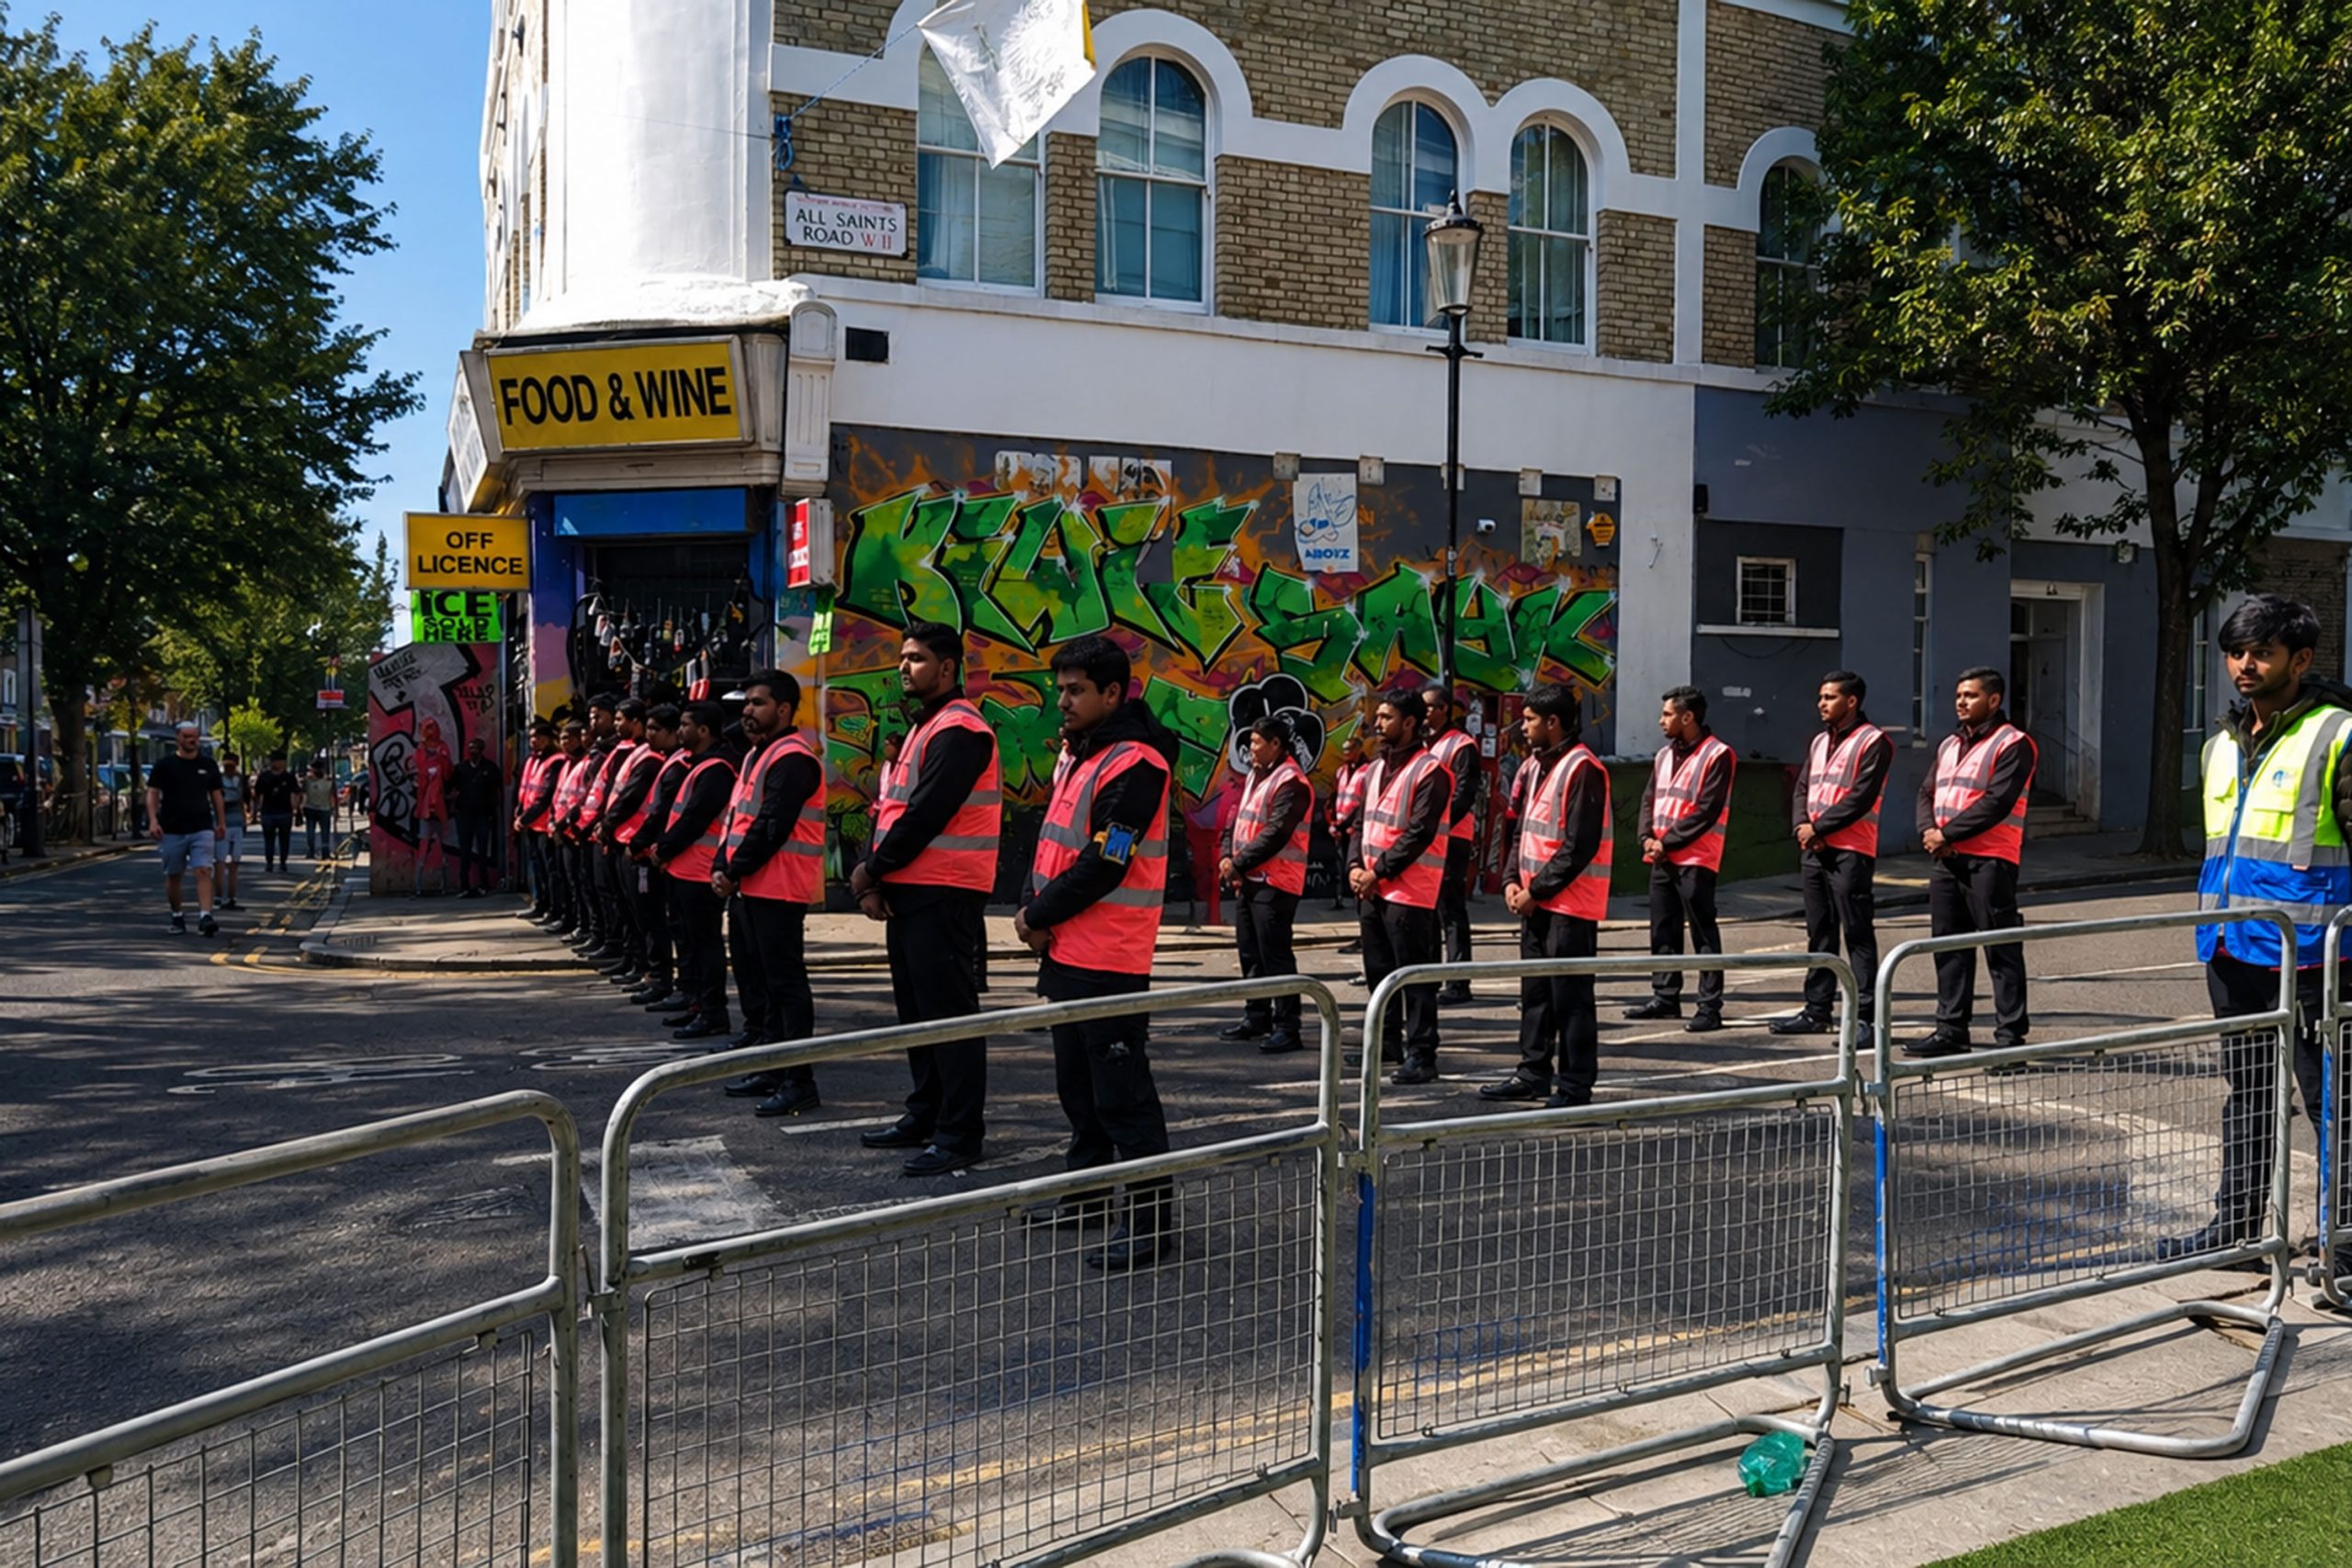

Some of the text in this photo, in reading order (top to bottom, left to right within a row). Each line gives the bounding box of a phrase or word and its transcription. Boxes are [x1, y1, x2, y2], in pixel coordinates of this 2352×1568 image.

[796, 209, 897, 232] ALL SAINTS
[803, 226, 854, 245] ROAD
[500, 367, 731, 426] FOOD & WINE
[446, 531, 493, 549] OFF
[418, 555, 523, 575] LICENCE
[420, 591, 492, 617] ICE
